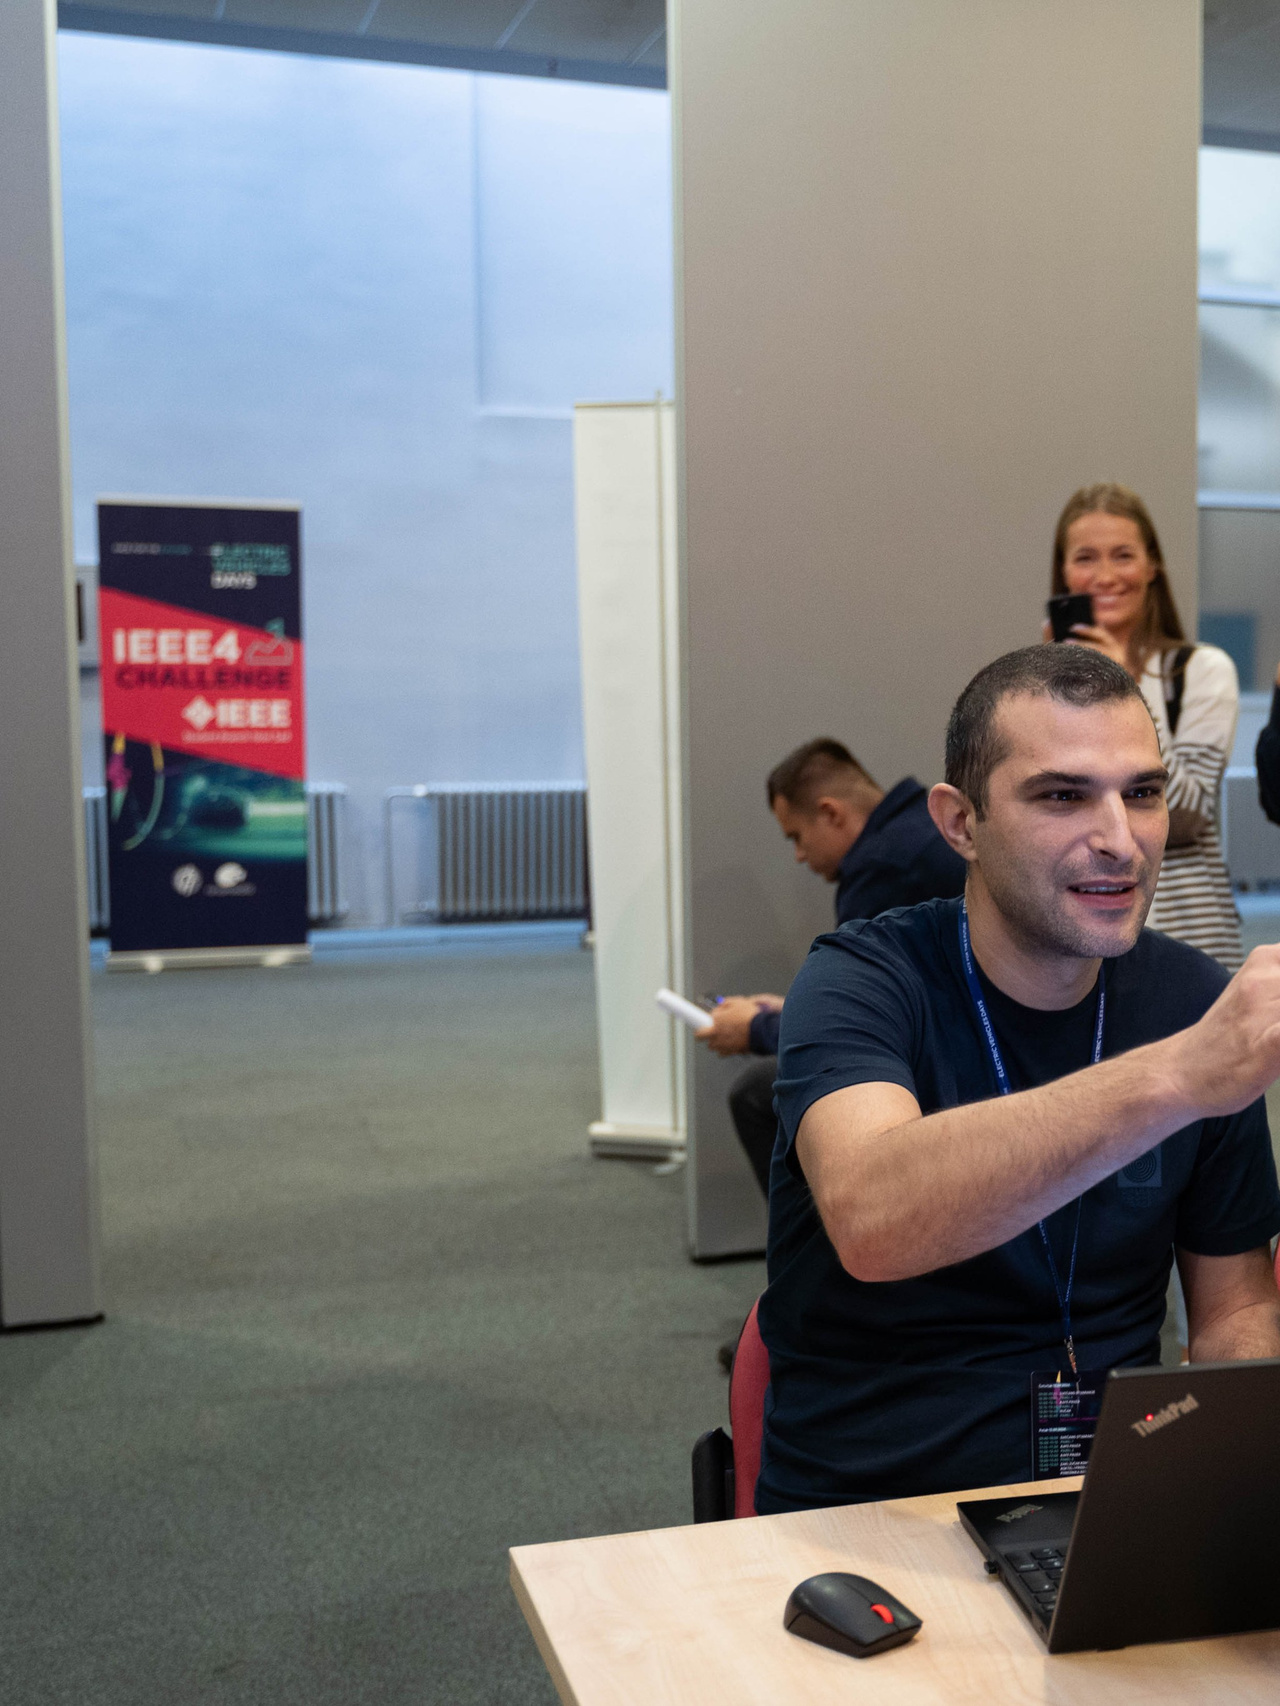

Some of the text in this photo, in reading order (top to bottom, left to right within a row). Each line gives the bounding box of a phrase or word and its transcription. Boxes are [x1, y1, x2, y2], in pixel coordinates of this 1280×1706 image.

[113, 628, 242, 665] IEEE4
[115, 667, 292, 690] CHALLENGE
[216, 699, 291, 729] IEEE
[977, 1000, 1005, 1078] ELECTRIC VEHICLES DAYS
[1131, 1393, 1199, 1438] ThinkPad
